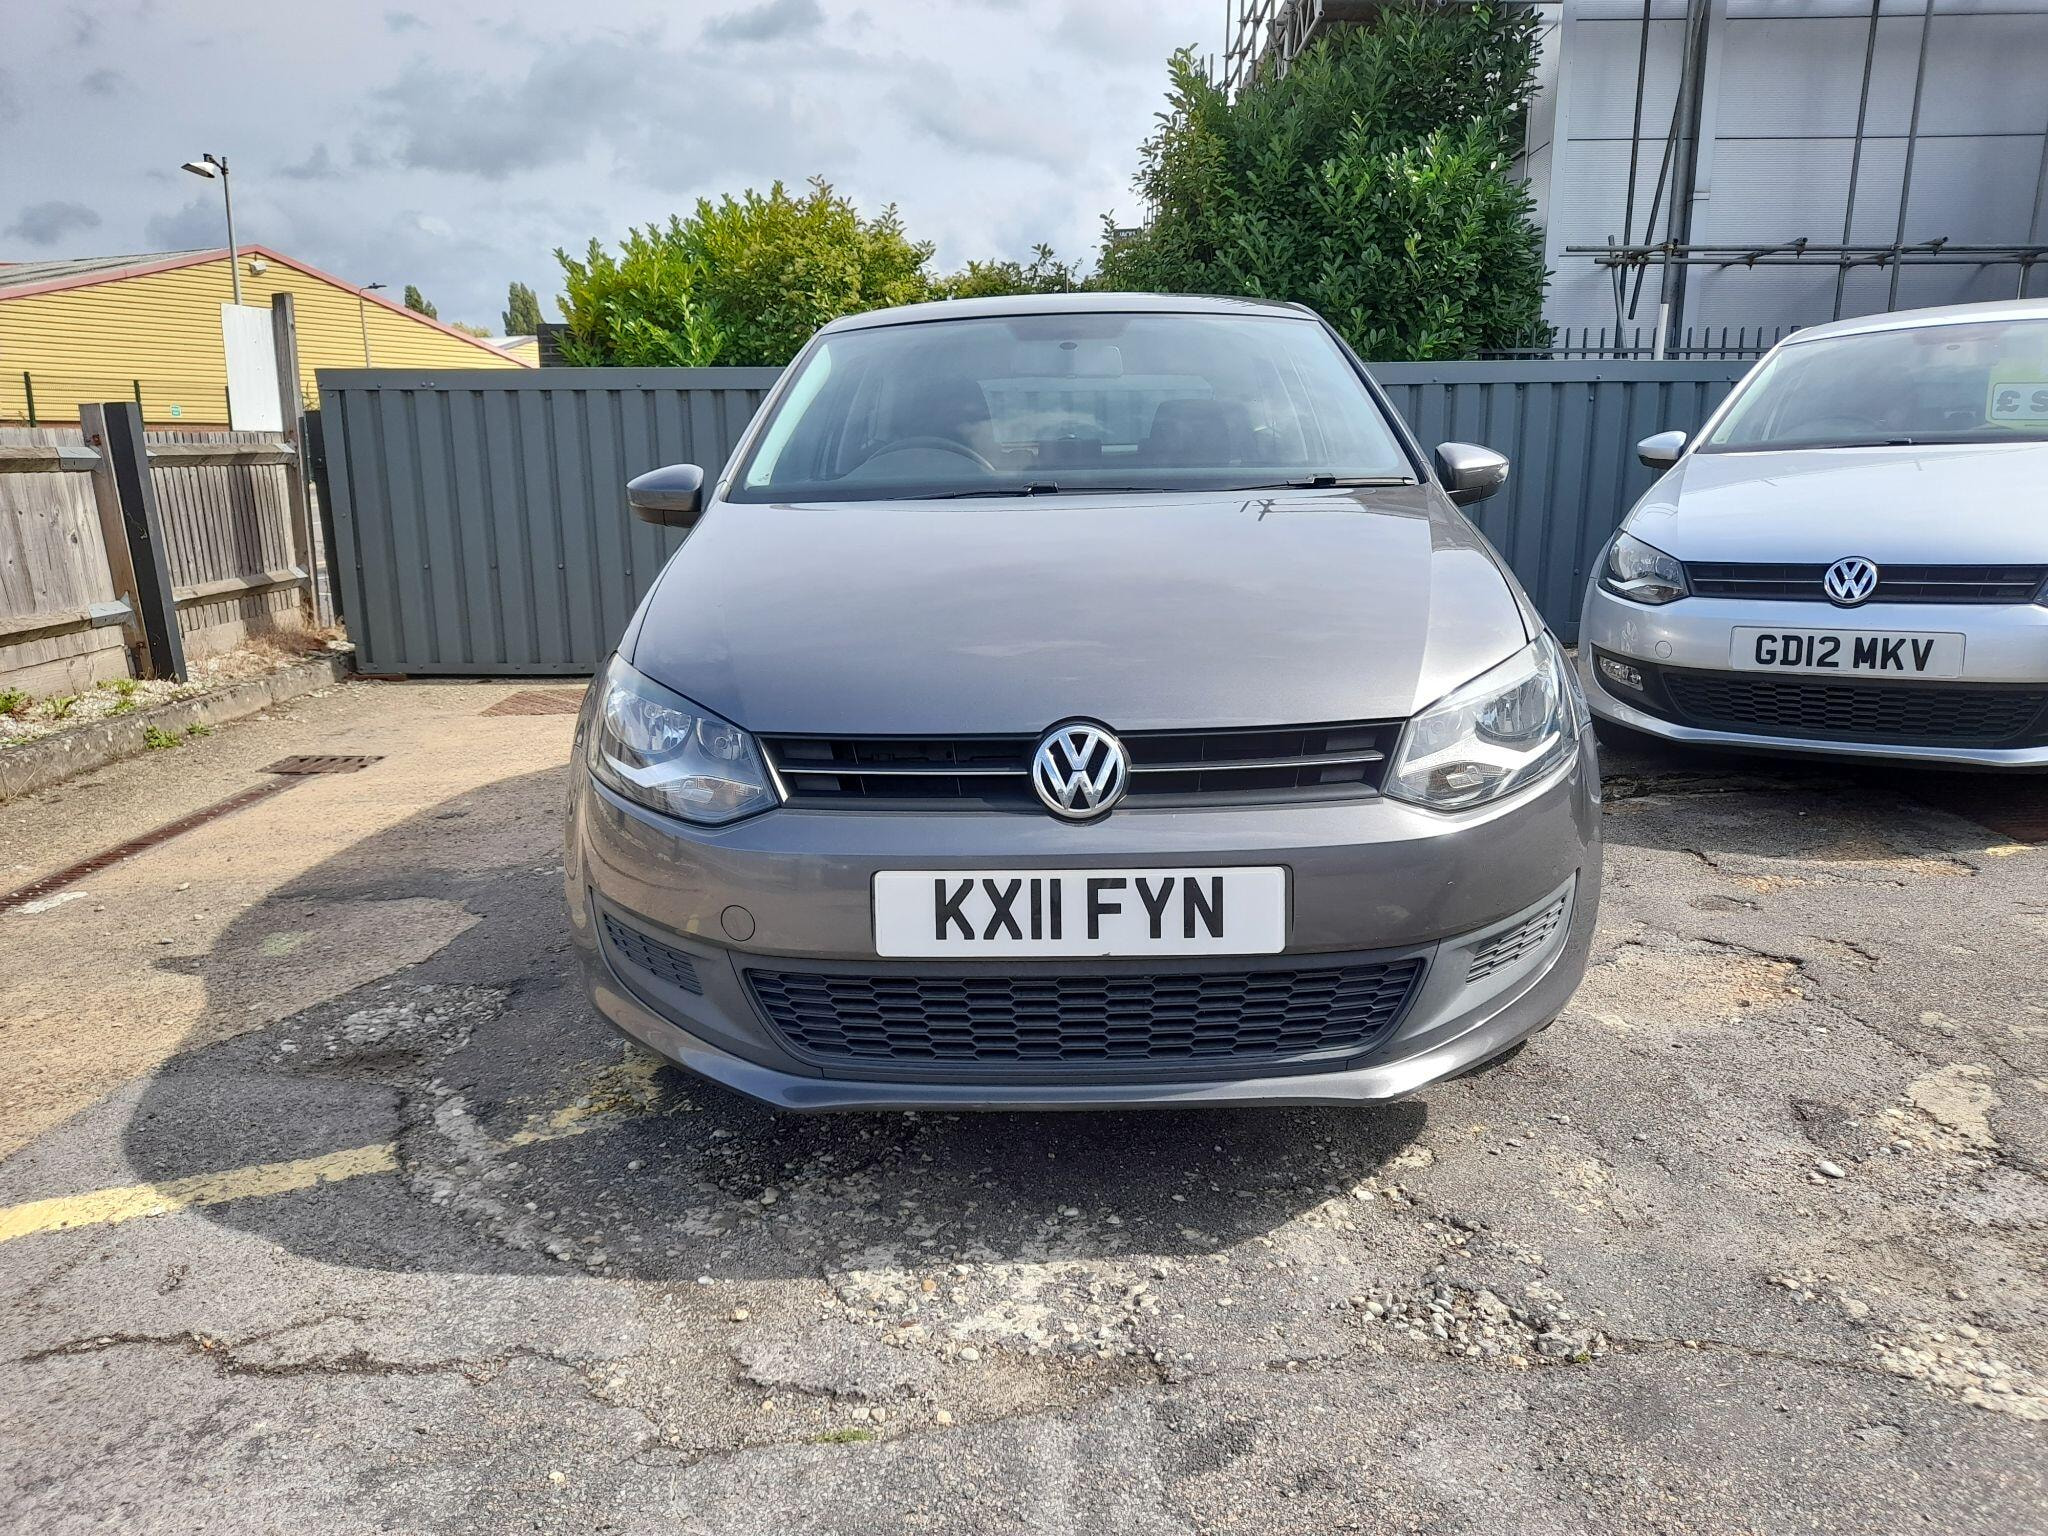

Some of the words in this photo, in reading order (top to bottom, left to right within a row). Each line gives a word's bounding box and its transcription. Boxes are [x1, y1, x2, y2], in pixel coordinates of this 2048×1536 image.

[1755, 634, 1841, 668] GD12
[1852, 636, 1935, 671] MKV
[1034, 727, 1125, 817] VW
[934, 878, 1062, 940] KX11
[1086, 876, 1224, 940] FYN
